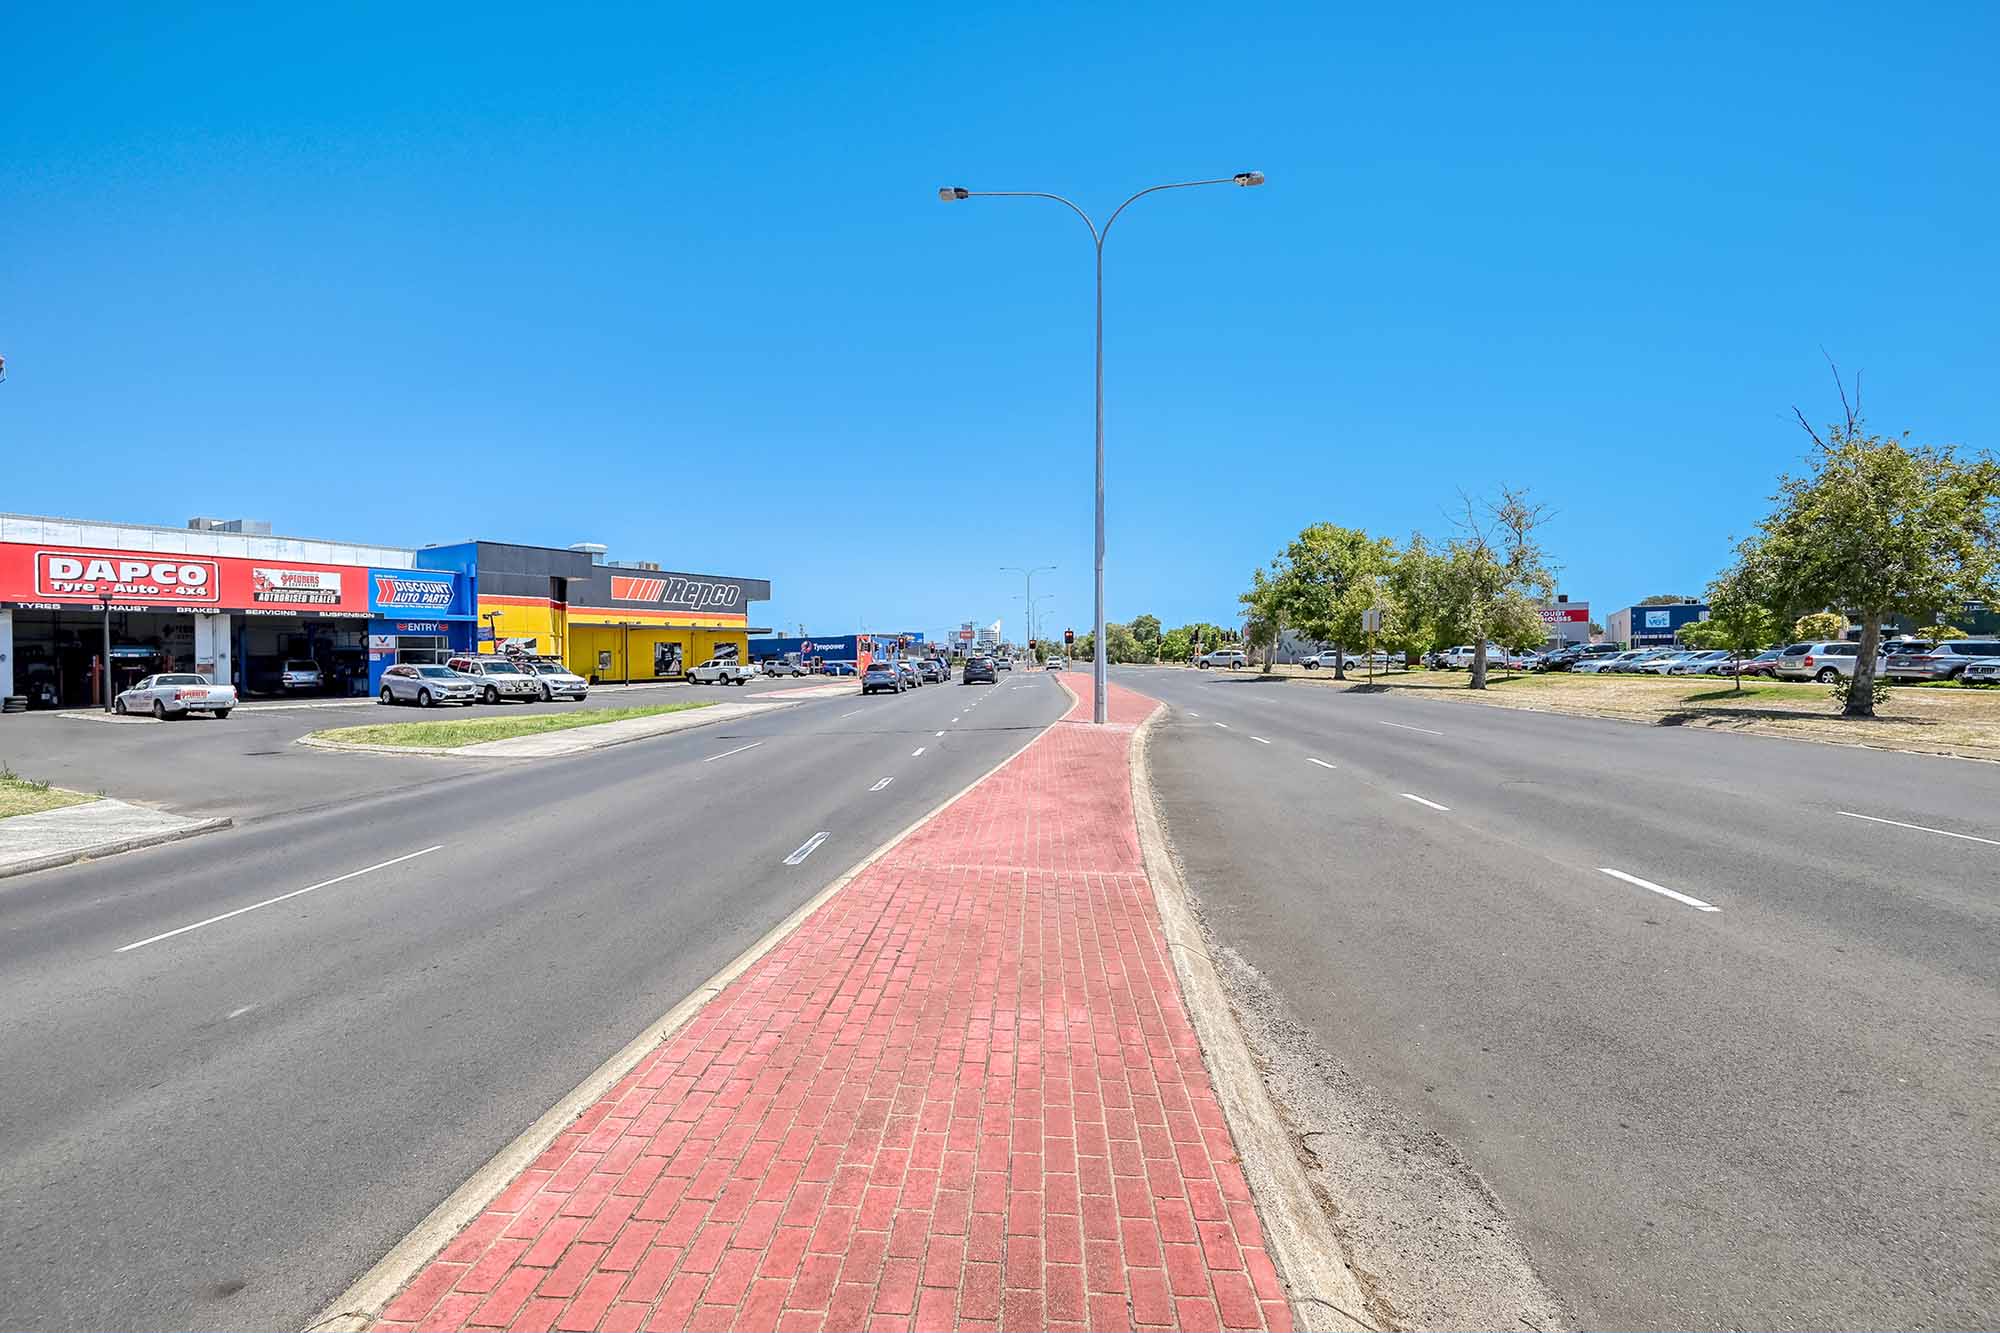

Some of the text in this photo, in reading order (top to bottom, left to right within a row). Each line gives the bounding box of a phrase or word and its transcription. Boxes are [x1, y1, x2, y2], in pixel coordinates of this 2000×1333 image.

[48, 557, 208, 586] DAPCO
[51, 580, 96, 594] Tyre
[113, 584, 159, 595] Auto
[394, 580, 450, 594] DISCOUNT
[258, 593, 337, 604] AUTHORISED DEALER
[394, 592, 450, 604] AUTO PARTS
[663, 577, 740, 610] Repco
[17, 602, 62, 610] TYRES
[407, 622, 438, 632] ENTRY
[813, 642, 846, 652] Tyrepower
